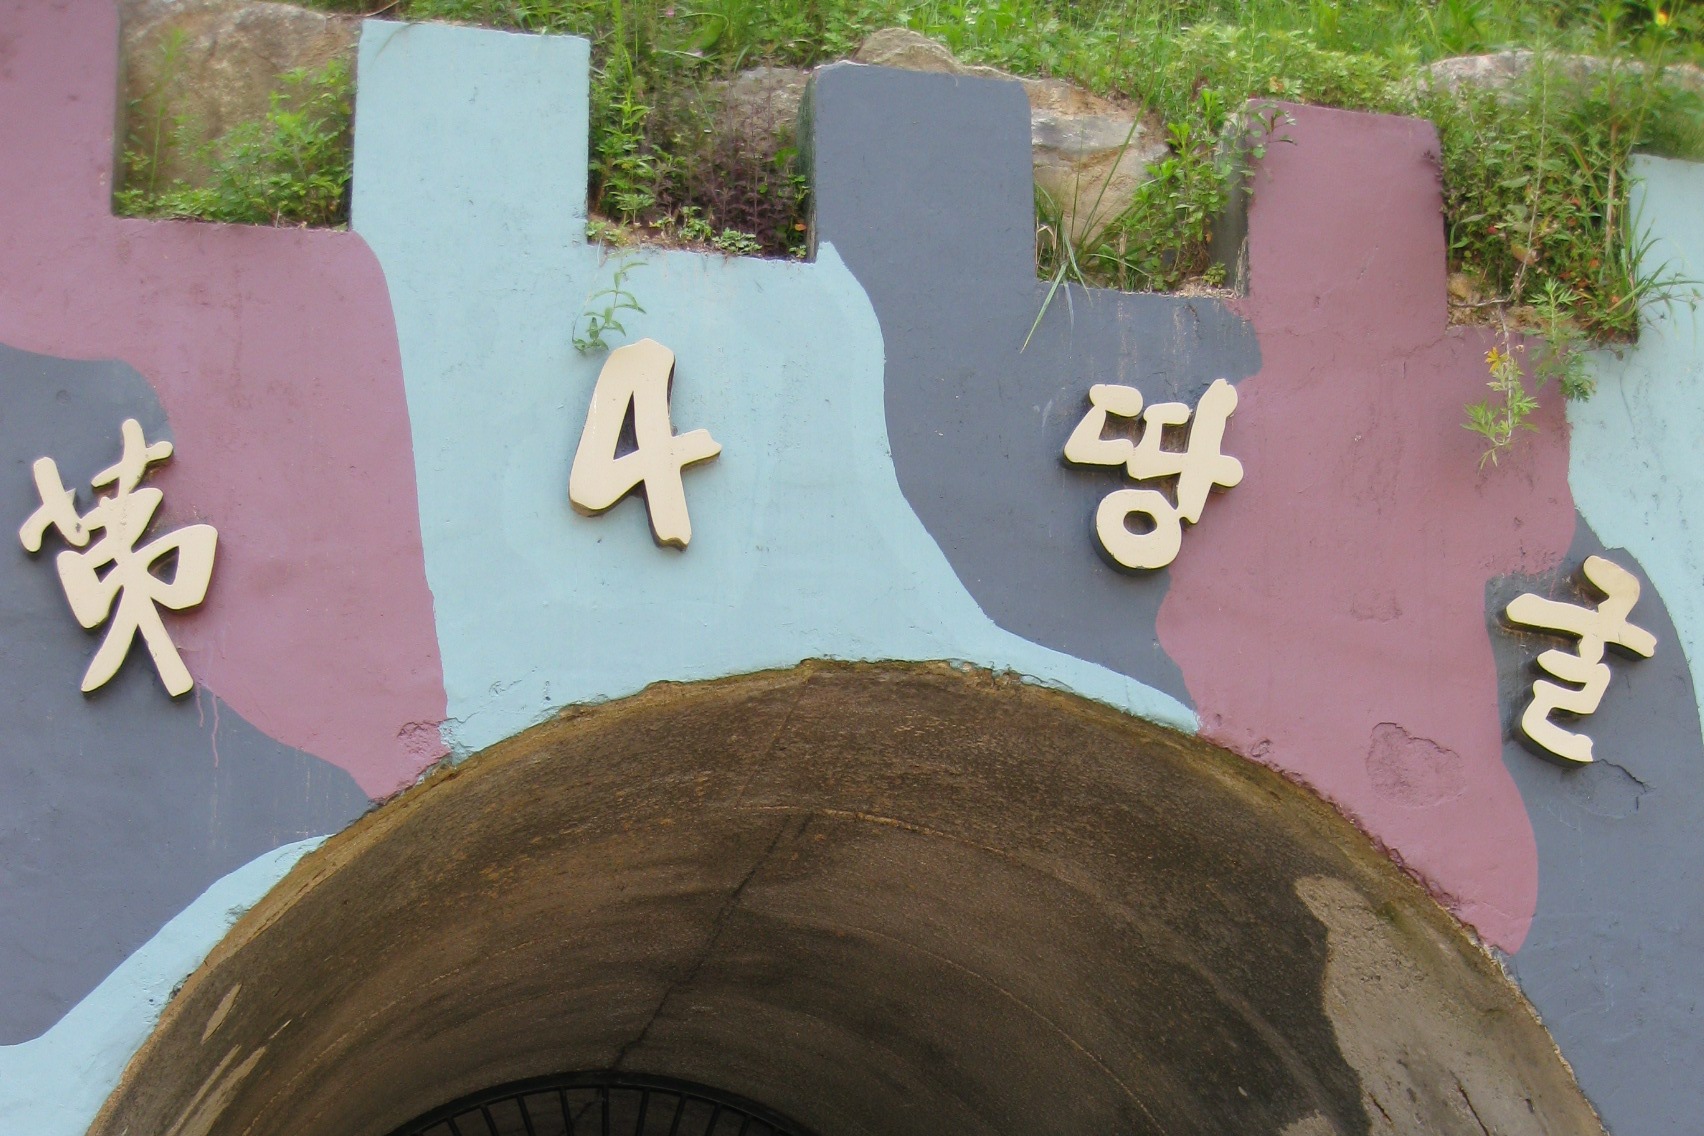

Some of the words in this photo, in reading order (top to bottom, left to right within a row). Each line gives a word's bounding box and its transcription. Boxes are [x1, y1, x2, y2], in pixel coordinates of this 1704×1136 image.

[568, 338, 722, 550] 4
[1063, 378, 1244, 570] 땅
[1505, 555, 1658, 763] 굴
